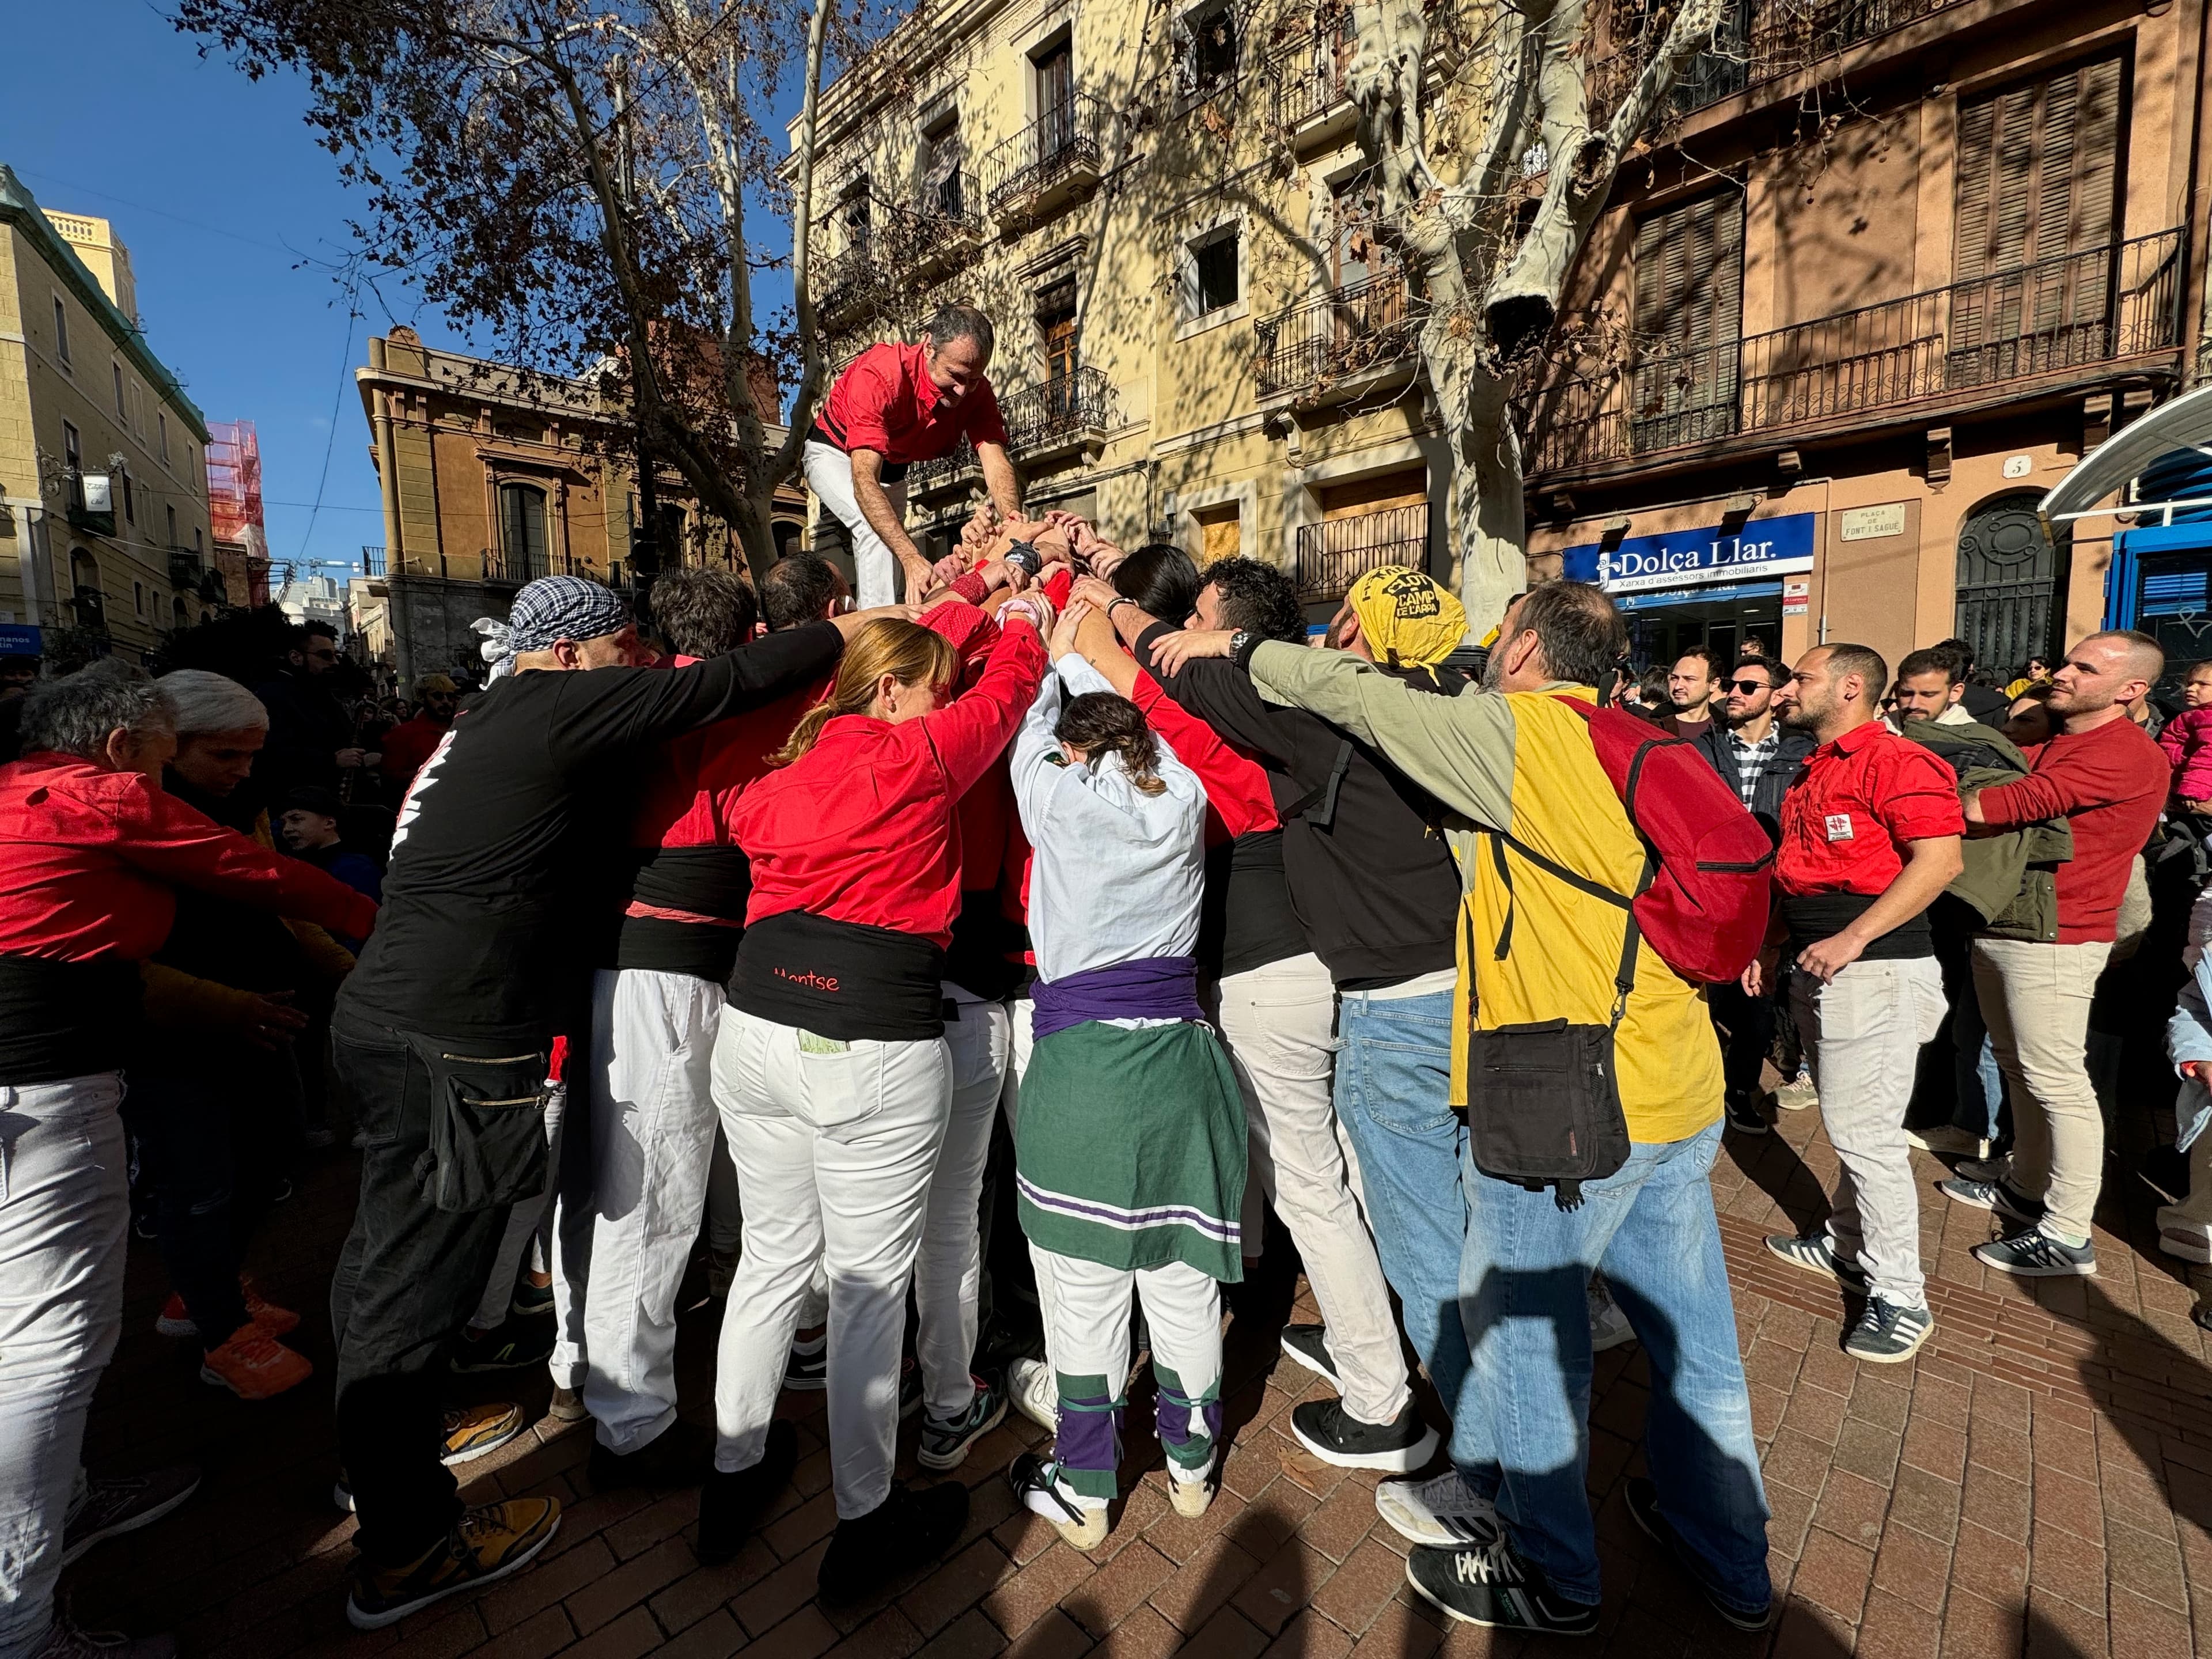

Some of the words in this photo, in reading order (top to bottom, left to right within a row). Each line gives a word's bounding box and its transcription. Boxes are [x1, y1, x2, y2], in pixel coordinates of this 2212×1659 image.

[2012, 461, 2021, 474] 5
[1846, 527, 1865, 535] FONT
[1619, 547, 1700, 576] Dolça
[1388, 574, 1430, 594] CLOT
[1619, 579, 1646, 588] Xarxa
[1648, 571, 1704, 585] d'assessors
[1707, 565, 1768, 579] immobiliaris
[1399, 590, 1435, 607] CAMP
[1410, 603, 1437, 615] L'ARPA
